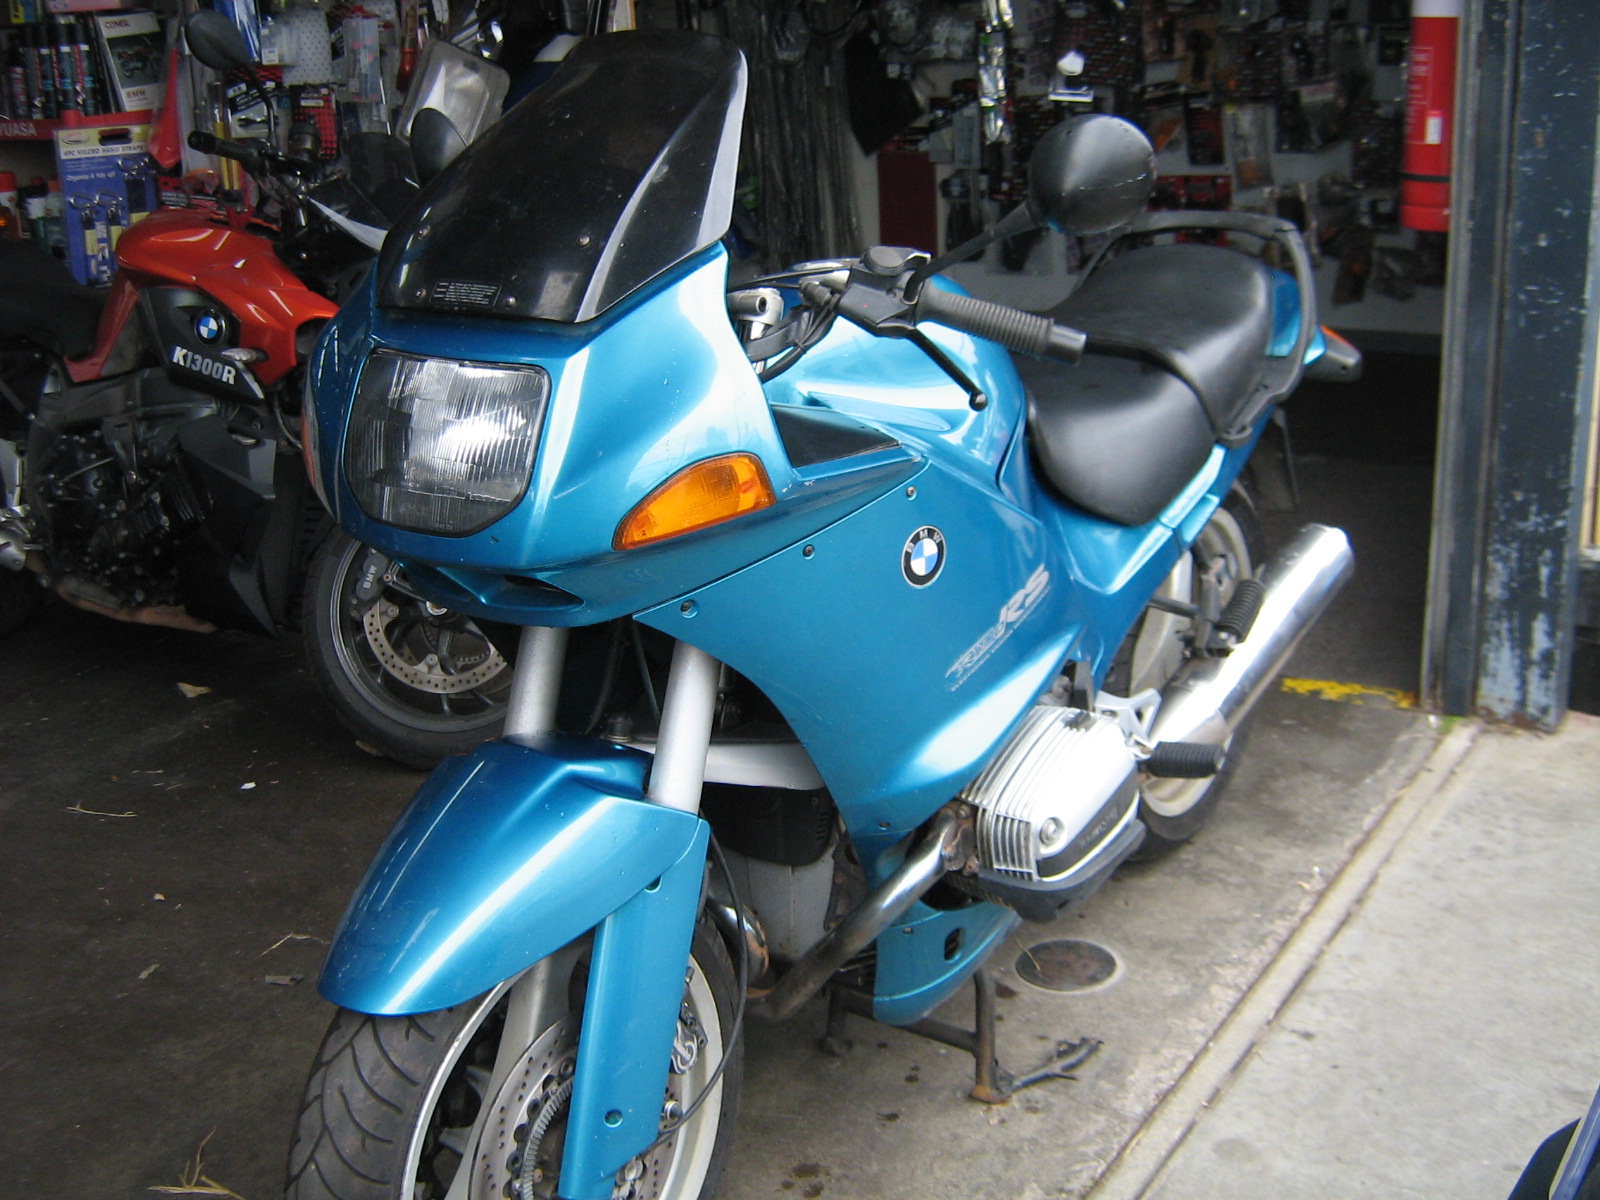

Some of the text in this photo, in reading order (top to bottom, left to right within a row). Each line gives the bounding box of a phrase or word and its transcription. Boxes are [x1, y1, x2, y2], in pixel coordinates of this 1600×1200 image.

[172, 345, 236, 385] K1300R
[906, 529, 943, 554] BMW
[363, 565, 378, 589] BMW
